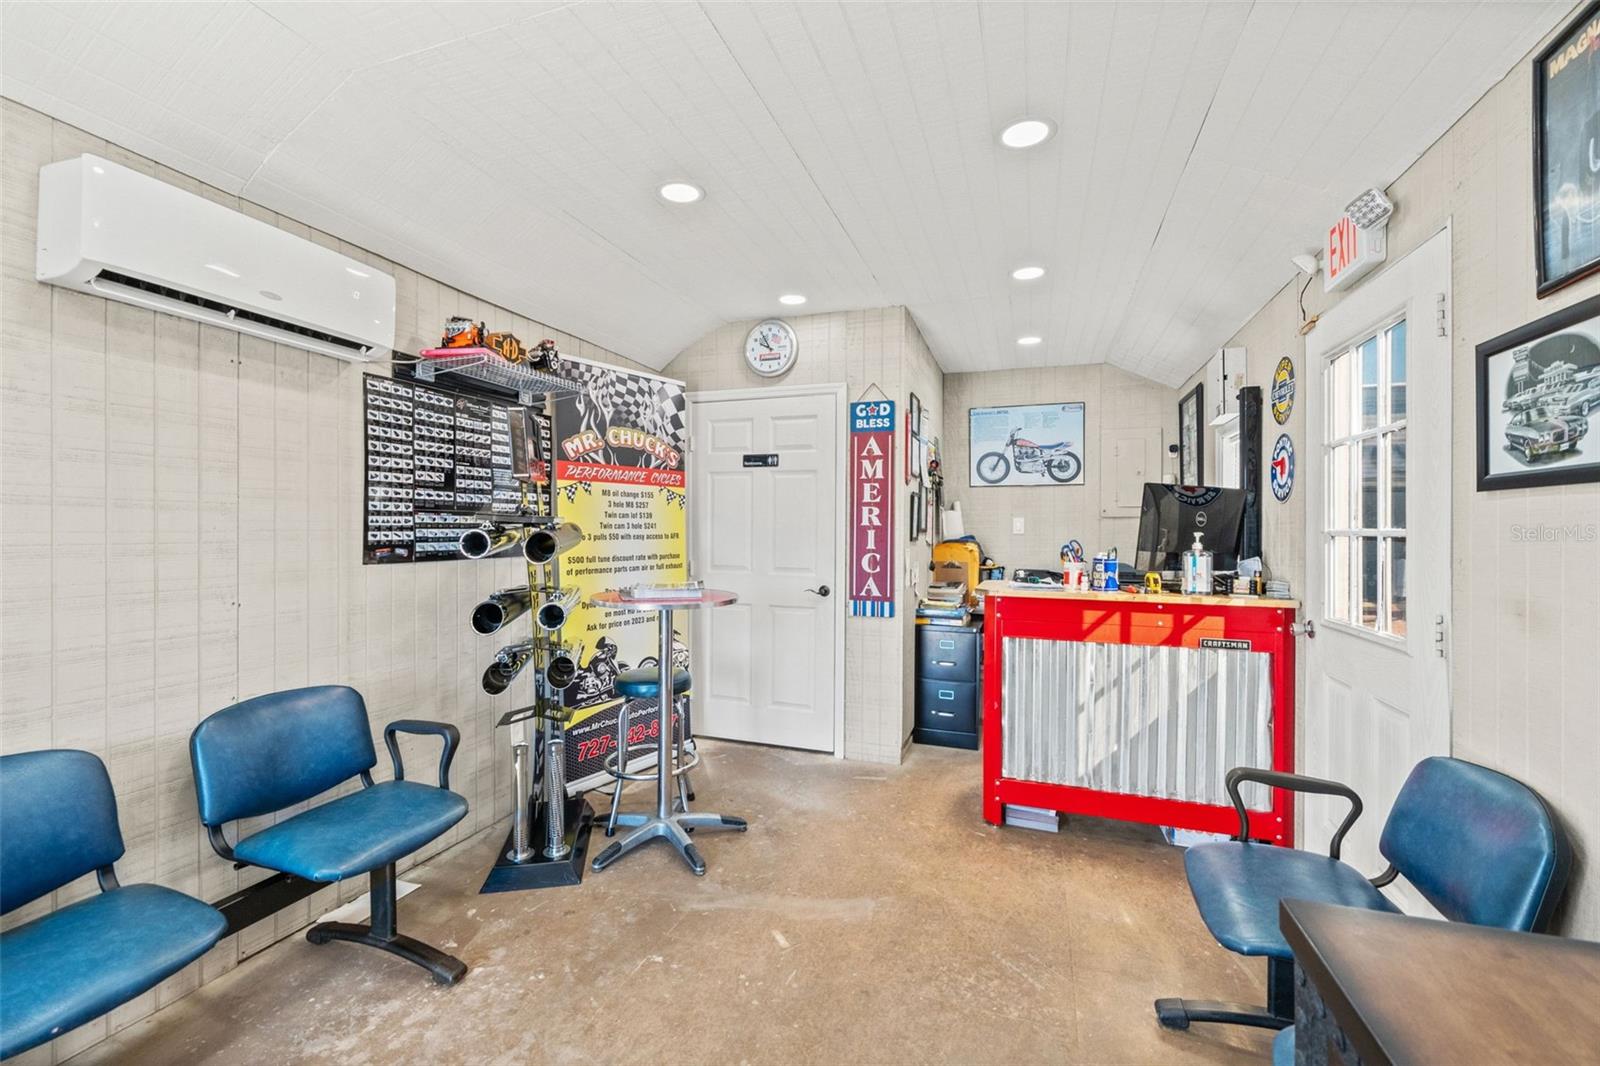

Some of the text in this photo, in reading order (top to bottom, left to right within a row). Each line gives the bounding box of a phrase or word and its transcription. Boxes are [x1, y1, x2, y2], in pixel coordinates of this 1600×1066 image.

[1549, 19, 1600, 79] MAGN
[856, 418, 890, 428] BLESS
[565, 429, 679, 467] MR. CHUCK'S
[565, 465, 682, 485] PERFORMANCE CYCLES
[620, 491, 640, 499] change
[860, 436, 885, 597] AMERICA
[593, 533, 607, 542] pulls
[568, 556, 584, 564] $500
[659, 553, 680, 561] purchase
[566, 568, 573, 576] of
[575, 566, 612, 578] performance
[614, 566, 628, 574] parts
[586, 624, 598, 632] Ask
[608, 620, 622, 630] price
[1203, 640, 1248, 649] CRAFTSMAN
